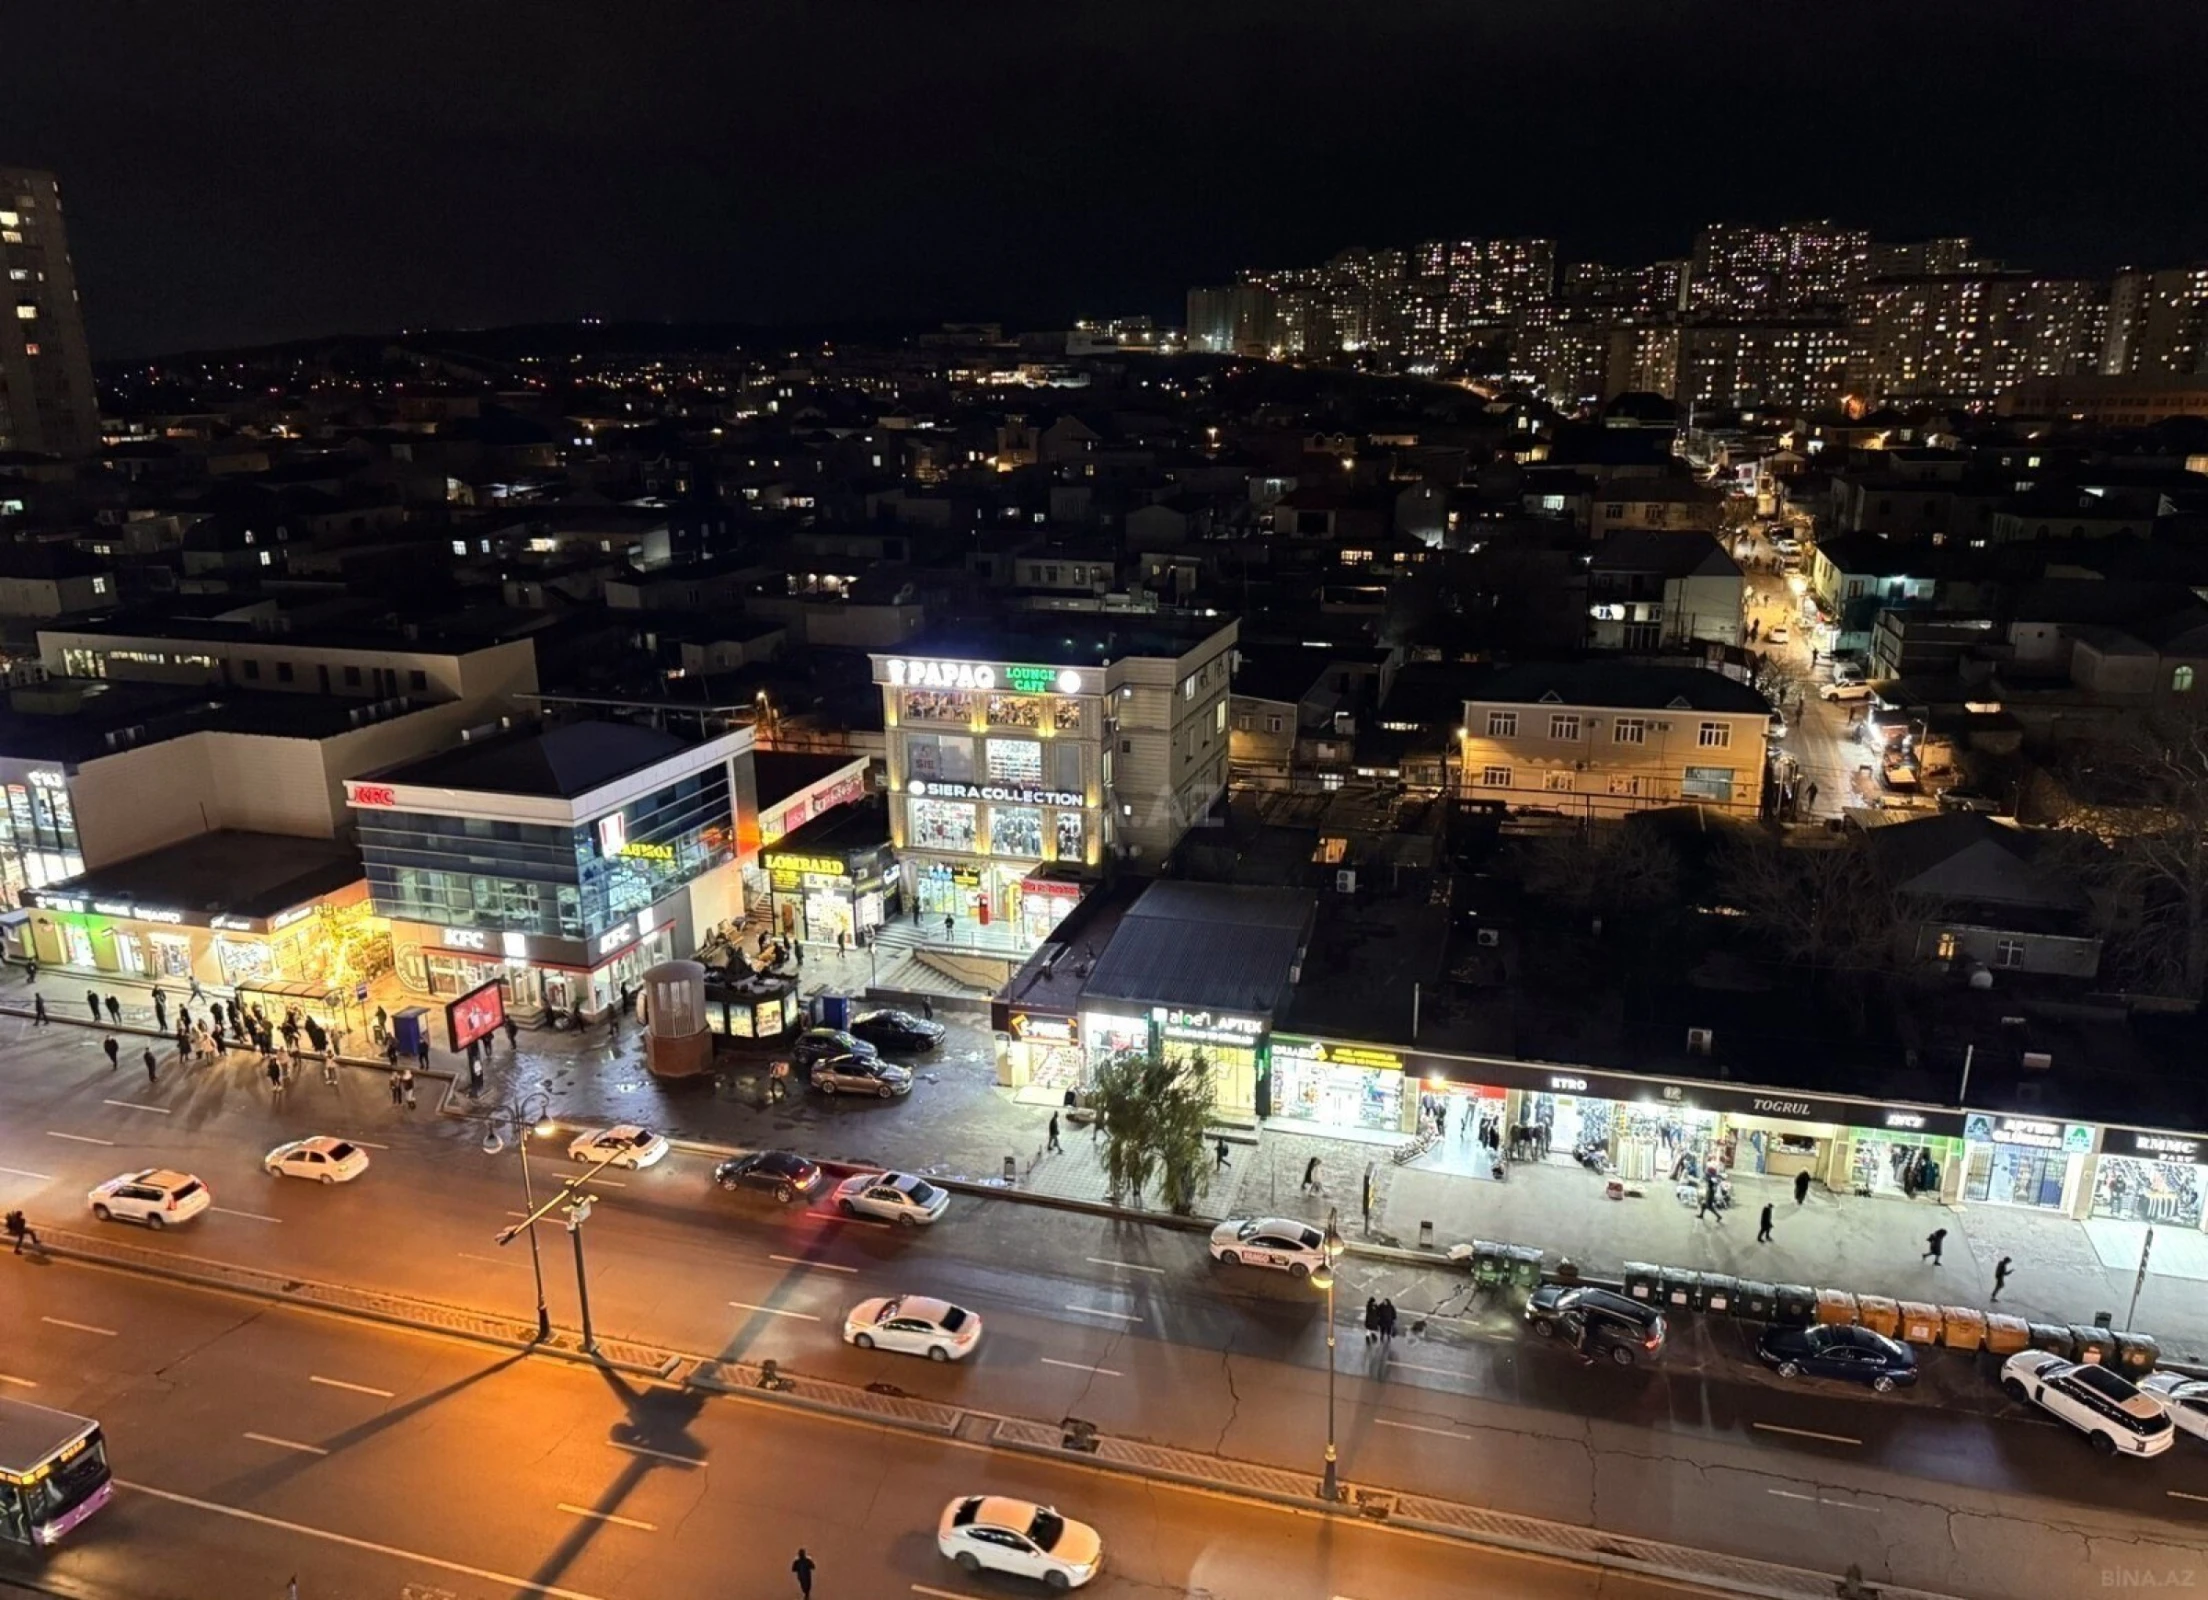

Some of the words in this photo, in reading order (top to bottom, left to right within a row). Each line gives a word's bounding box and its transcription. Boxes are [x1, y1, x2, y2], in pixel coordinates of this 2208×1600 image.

[908, 661, 995, 689] PAPAQ
[1006, 667, 1056, 682] LOUNGE
[1014, 680, 1046, 693] CAFE
[354, 786, 395, 806] KFC
[927, 783, 980, 799] SIERA
[981, 787, 1083, 807] COLLECTION
[765, 854, 845, 875] LOMBARD
[444, 928, 484, 949] KFC
[600, 922, 632, 954] KFC
[1218, 1016, 1262, 1034] APTEK
[2136, 1136, 2198, 1154] RMMC
